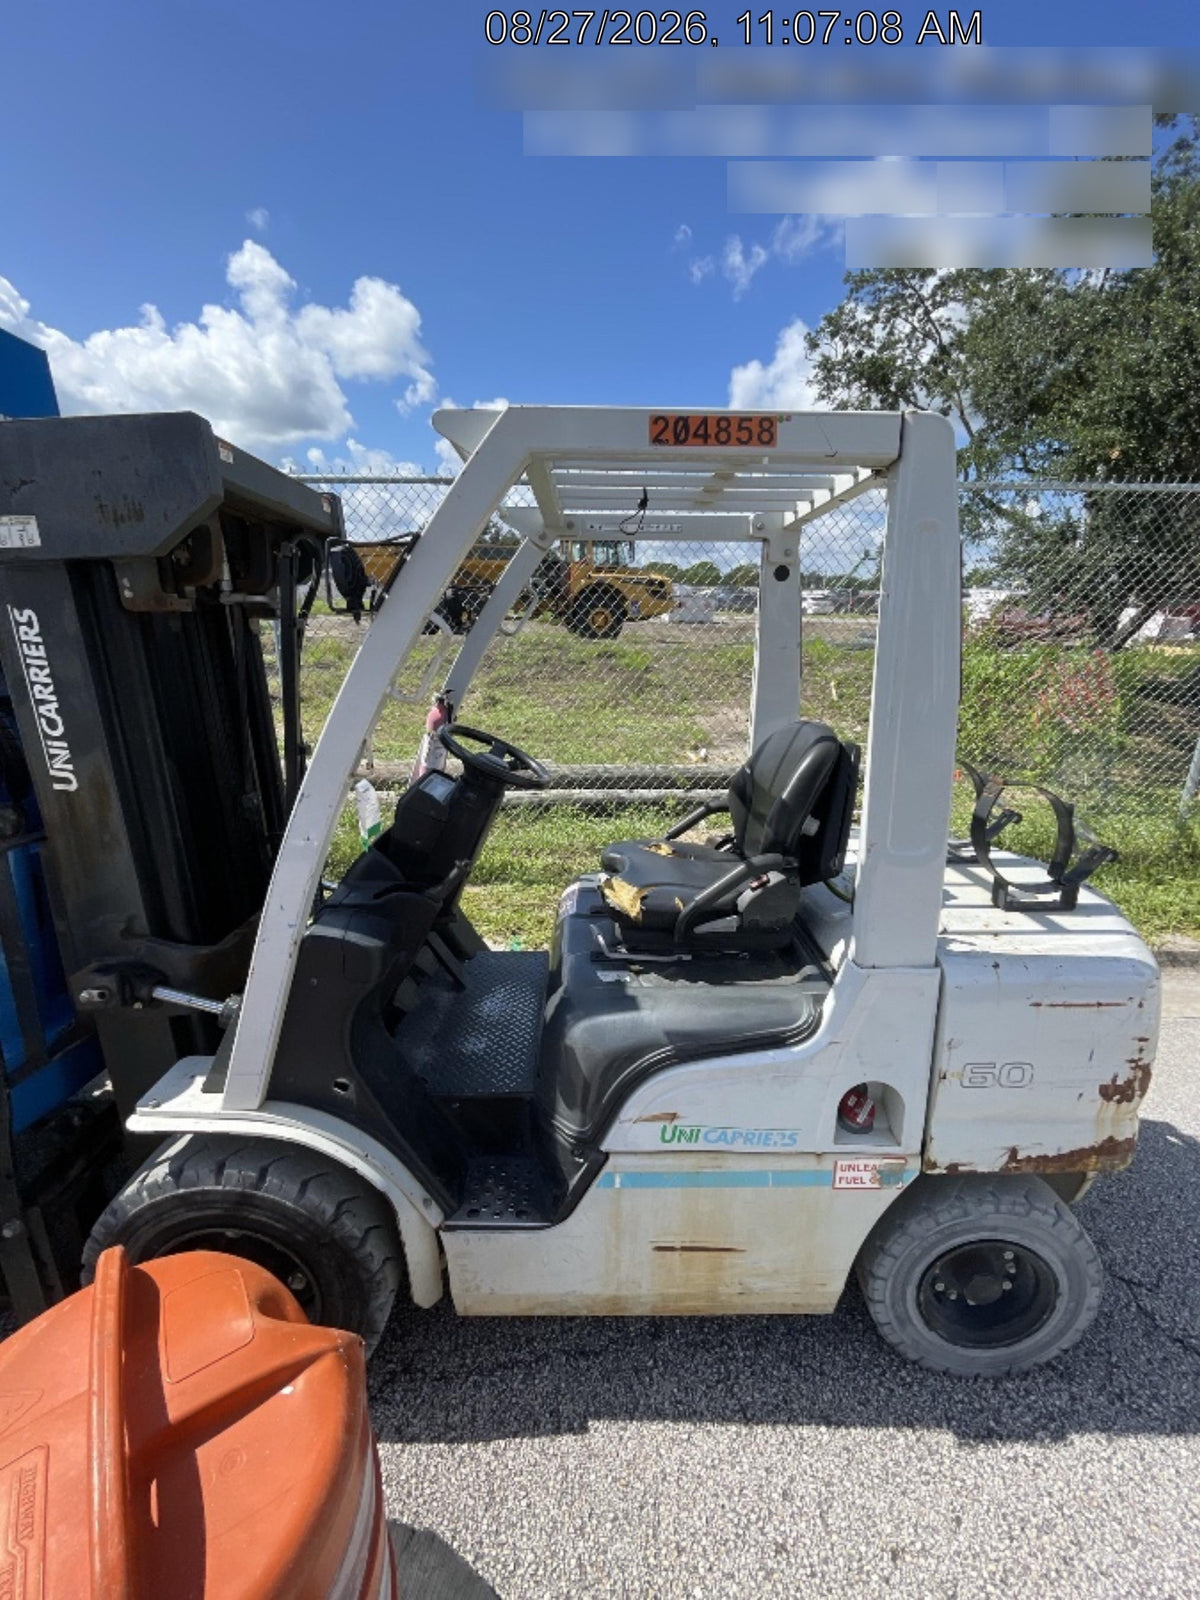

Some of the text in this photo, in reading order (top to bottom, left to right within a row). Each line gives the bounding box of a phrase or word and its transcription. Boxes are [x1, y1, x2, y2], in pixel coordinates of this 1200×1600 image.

[651, 415, 775, 446] 204858
[840, 1163, 882, 1173] UNLEA
[838, 1175, 867, 1185] FUEL
